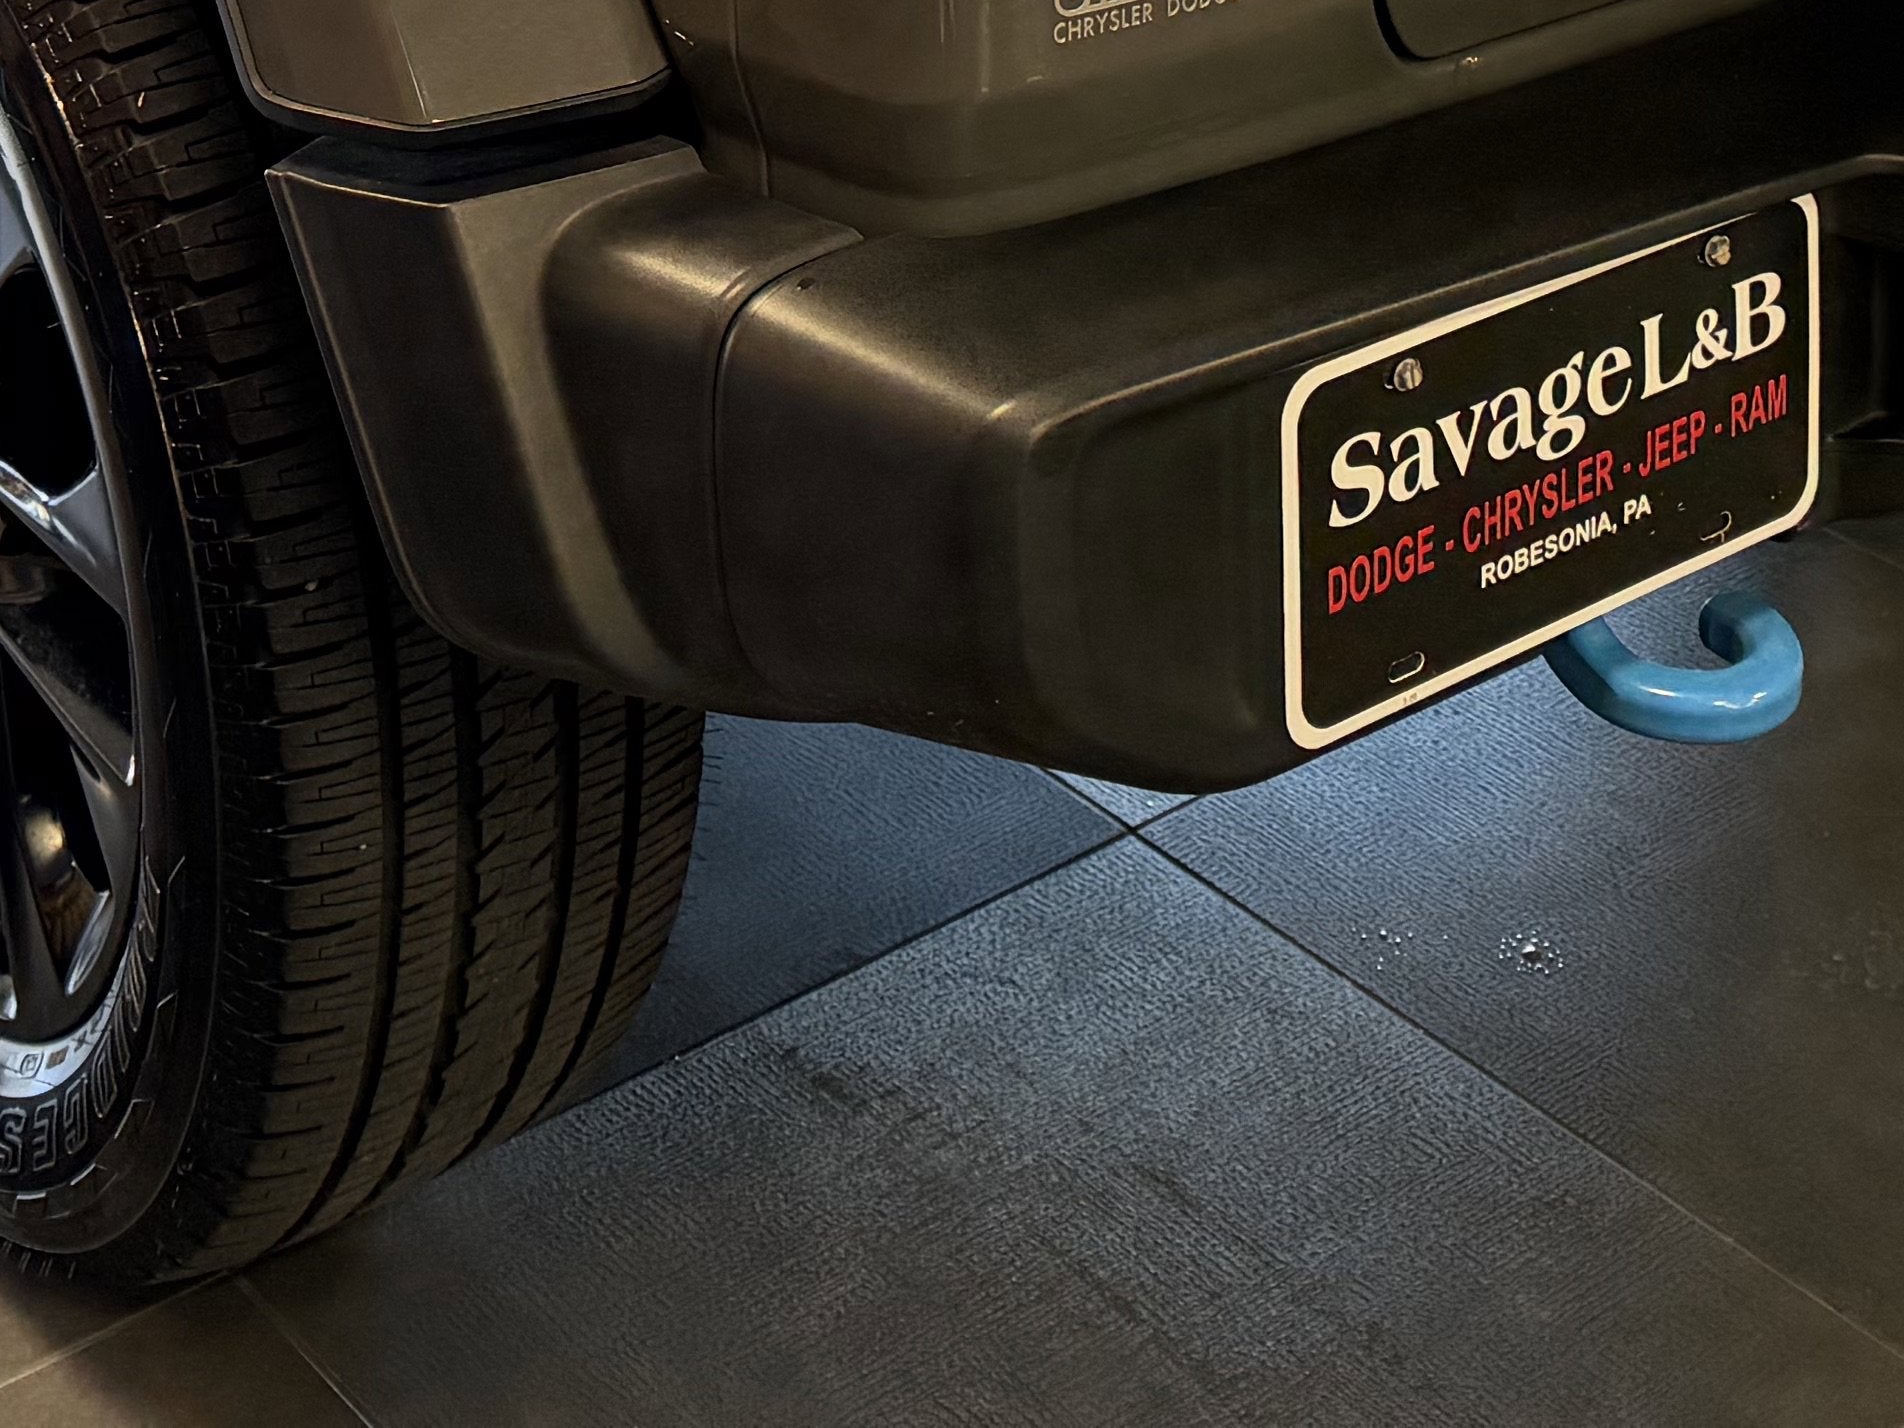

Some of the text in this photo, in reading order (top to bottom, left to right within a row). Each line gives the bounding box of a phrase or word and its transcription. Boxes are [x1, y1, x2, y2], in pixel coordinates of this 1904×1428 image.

[1054, 2, 1153, 44] CHRYSLER
[1327, 524, 1436, 615] DODGE
[1462, 450, 1615, 555] CHRYSLER
[1638, 410, 1706, 478] JEEP
[1729, 374, 1788, 439] RAM
[1480, 494, 1653, 589] ROBESONIA, PA
